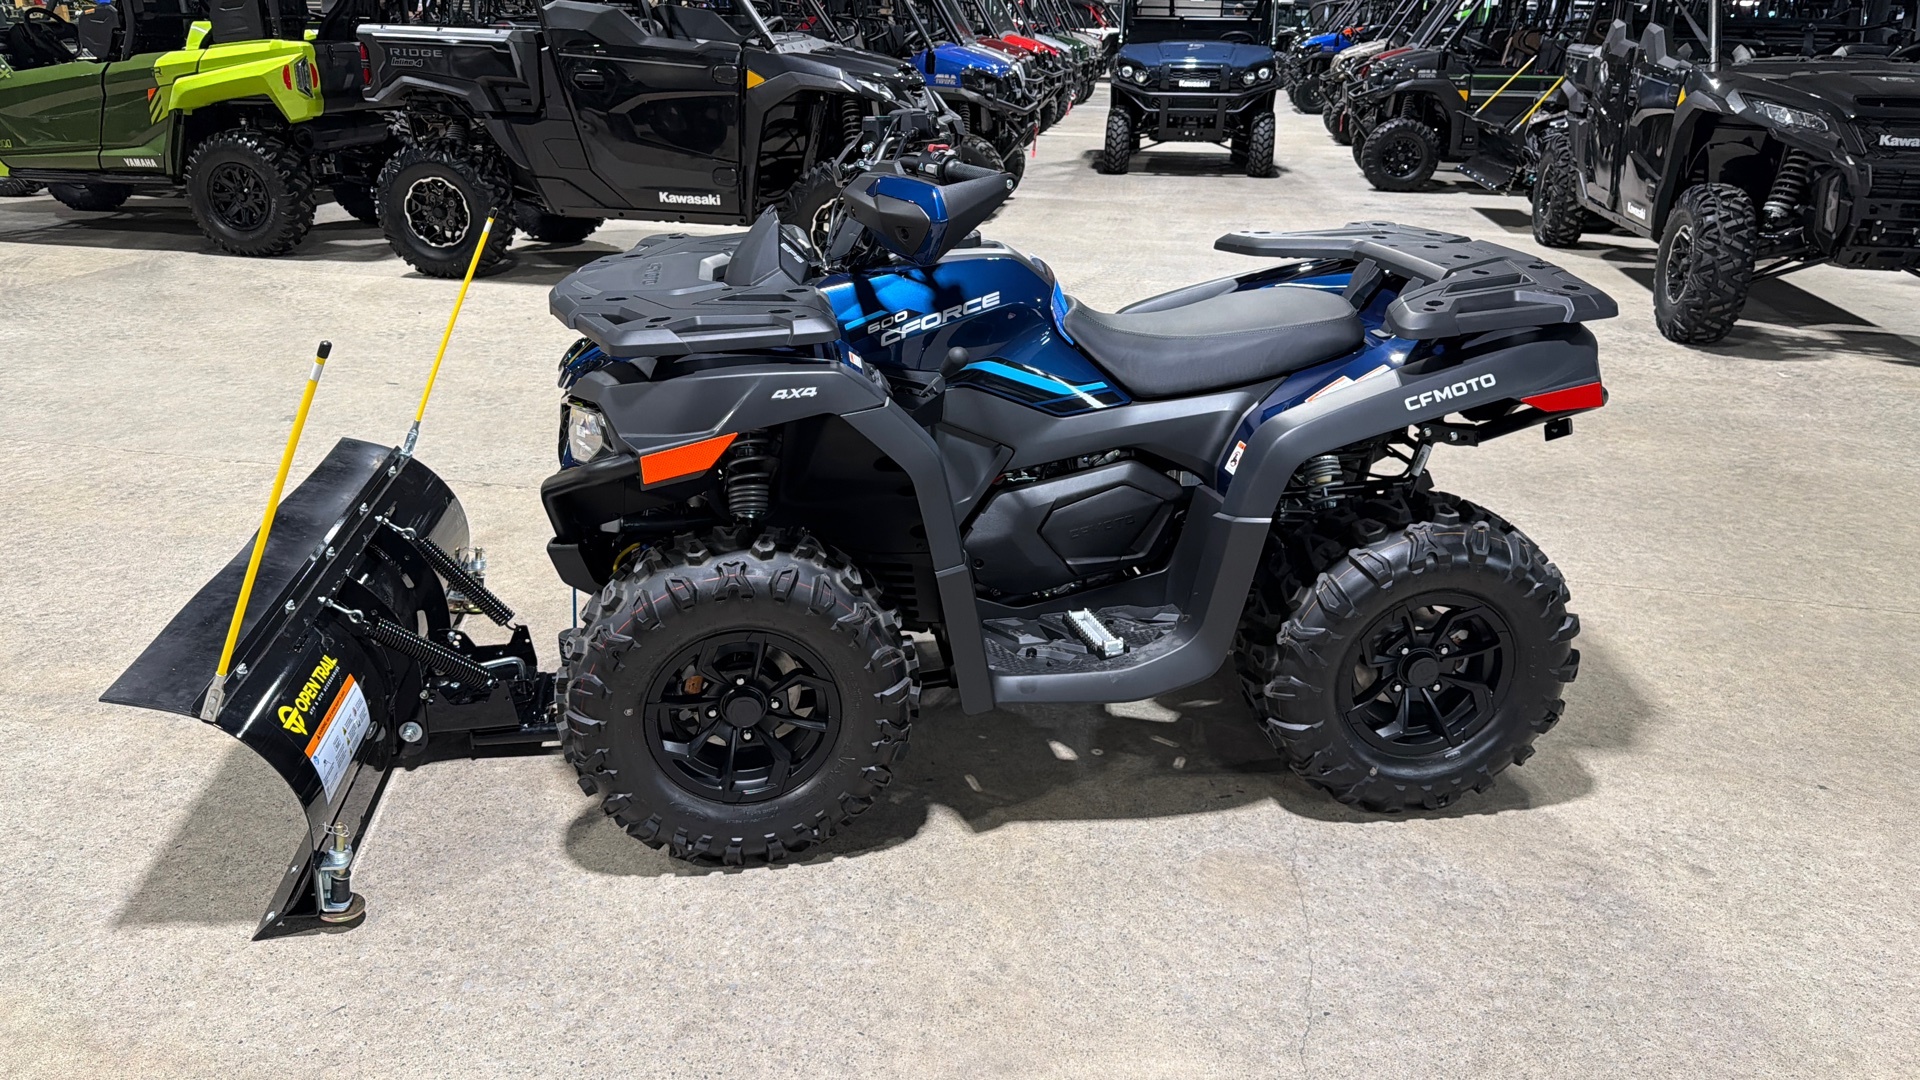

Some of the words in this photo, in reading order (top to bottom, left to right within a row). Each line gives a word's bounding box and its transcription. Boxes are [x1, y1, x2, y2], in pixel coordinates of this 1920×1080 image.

[389, 47, 443, 57] RIDGE
[123, 158, 158, 168] YAMAHA
[658, 191, 721, 206] Kawasaki
[780, 242, 805, 264] EPS
[867, 310, 908, 334] 600
[881, 291, 1000, 347] CFORCE
[1404, 373, 1496, 411] CFMOTO
[295, 677, 321, 712] OPEN
[311, 654, 338, 683] TRAIL
